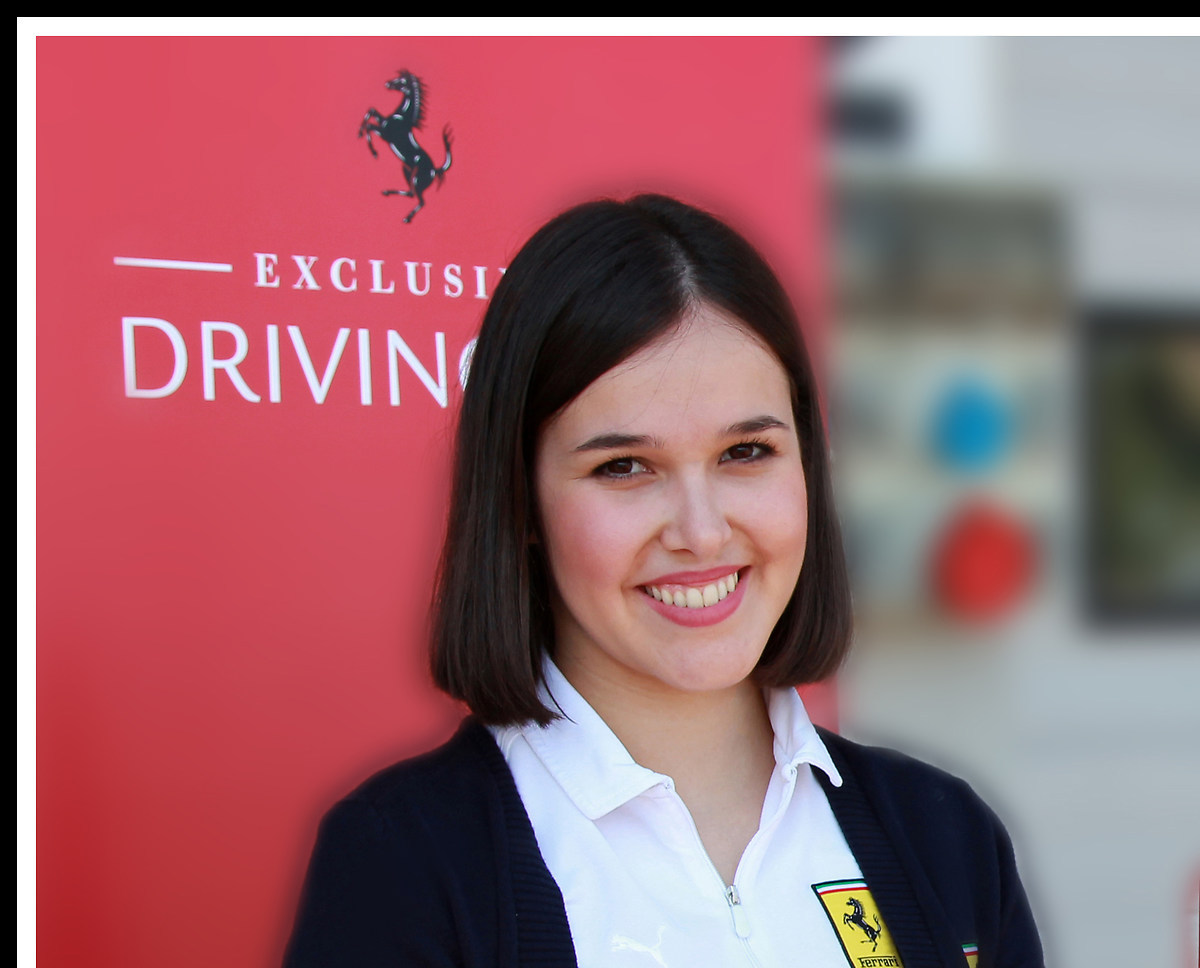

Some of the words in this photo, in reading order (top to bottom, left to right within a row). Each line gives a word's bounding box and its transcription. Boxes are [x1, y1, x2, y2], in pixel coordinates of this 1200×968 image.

[254, 252, 507, 299] EXCLUSI
[121, 316, 479, 408] DRIVIN
[857, 955, 900, 968] Ferrari
